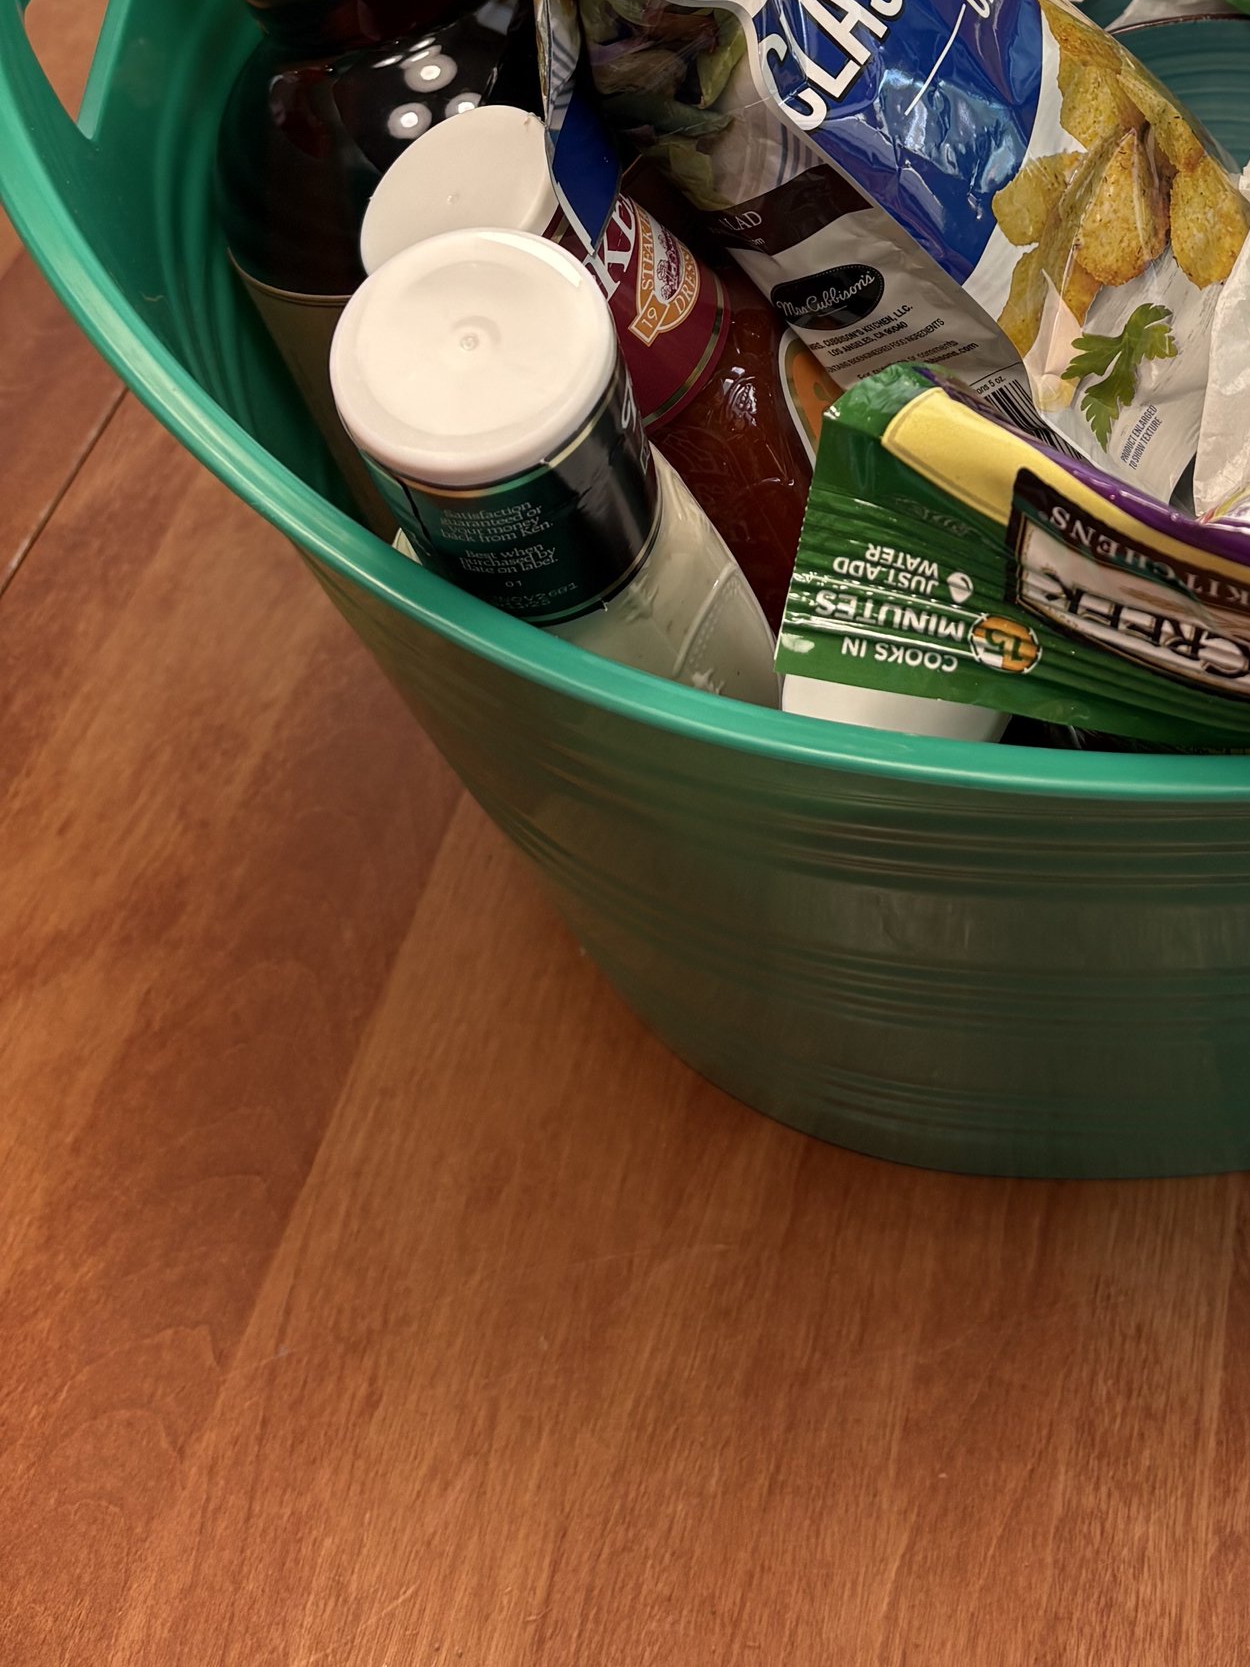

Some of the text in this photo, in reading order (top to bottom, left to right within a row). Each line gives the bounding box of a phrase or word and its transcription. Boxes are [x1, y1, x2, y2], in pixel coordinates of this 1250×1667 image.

[719, 210, 762, 231] LAD
[641, 307, 659, 329] 19
[861, 314, 898, 333] KITCHEN,
[893, 304, 914, 319] LLC.
[828, 330, 887, 357] LOS ANGELES, CA
[988, 379, 995, 388] 5
[1120, 404, 1158, 463] PRODUCT ENLARGED
[1128, 416, 1163, 470] TO SHOW TEXTURE
[526, 505, 542, 517] or
[500, 543, 545, 559] when
[864, 542, 940, 580] WATER
[497, 565, 518, 574] on
[832, 555, 940, 596] JUST ADD
[814, 589, 967, 642] MINUTES
[840, 636, 959, 673] COOKS IN
